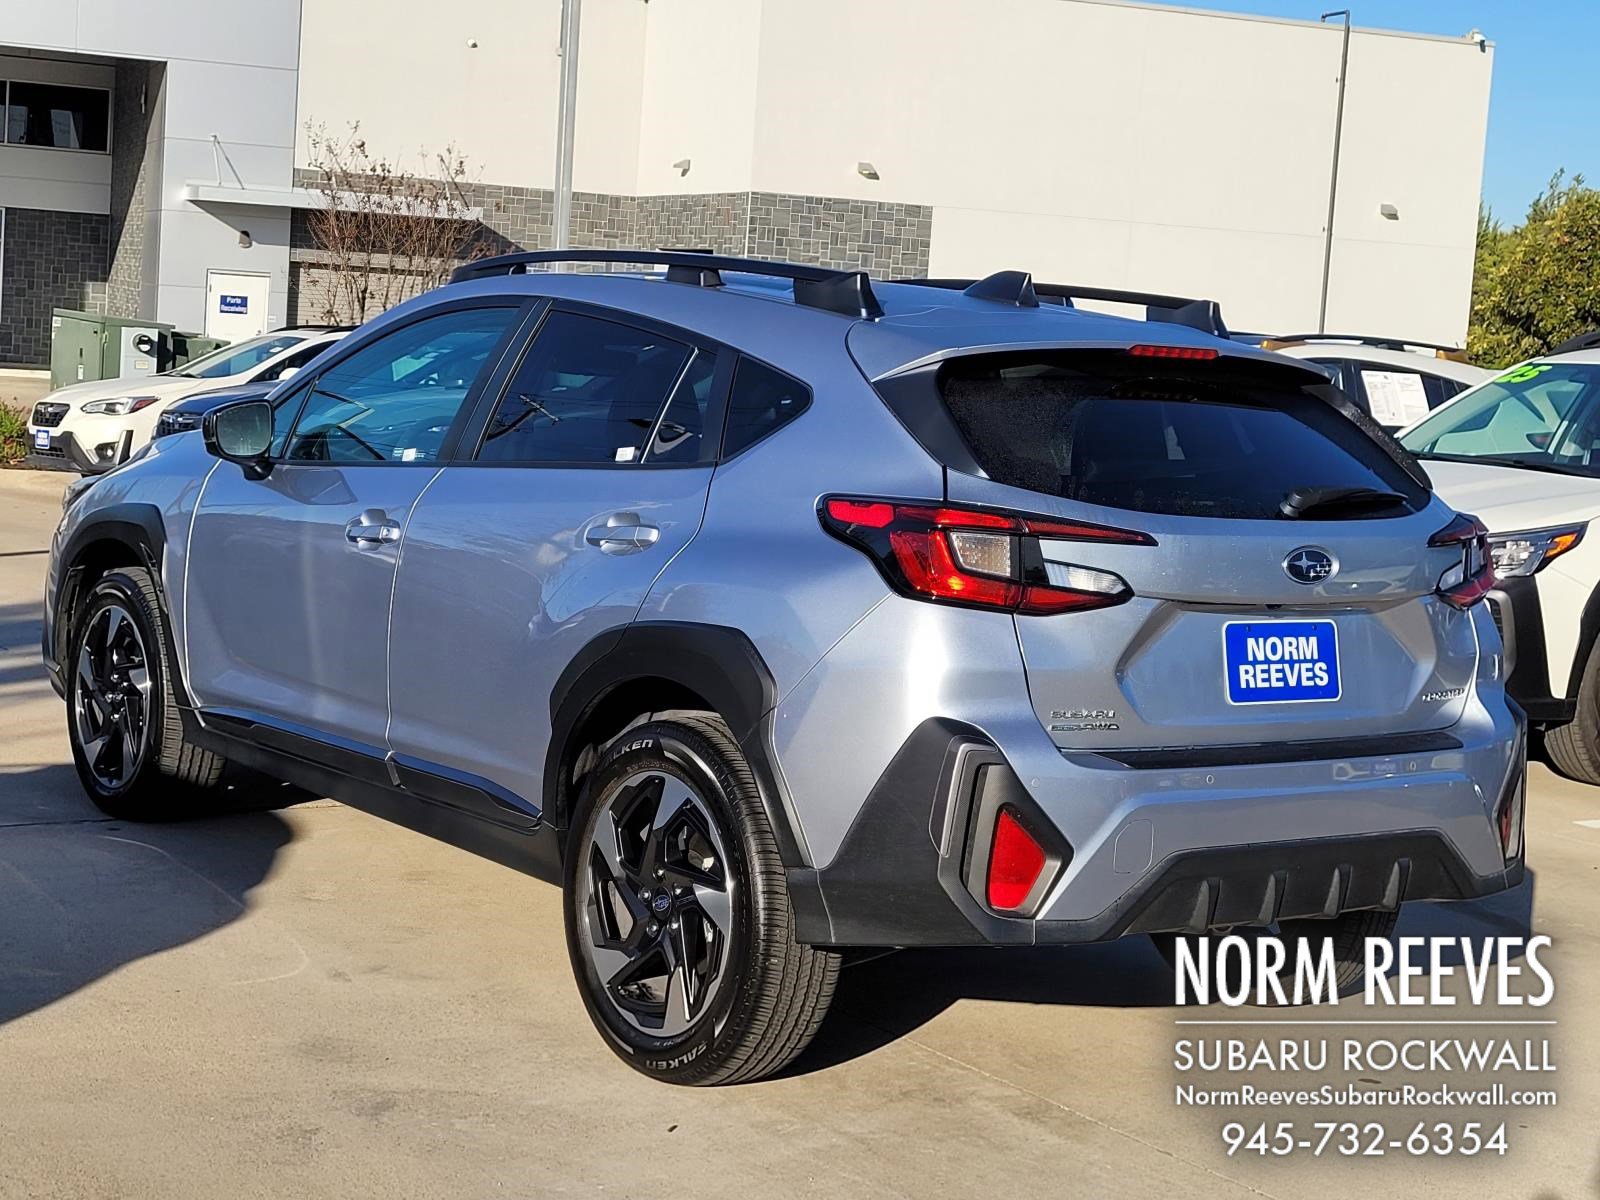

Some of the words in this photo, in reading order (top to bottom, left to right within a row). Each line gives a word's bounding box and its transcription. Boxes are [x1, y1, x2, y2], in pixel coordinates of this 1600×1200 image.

[1246, 636, 1319, 662] NORM
[1239, 662, 1329, 689] REEVES
[1050, 710, 1116, 719] SUBARU
